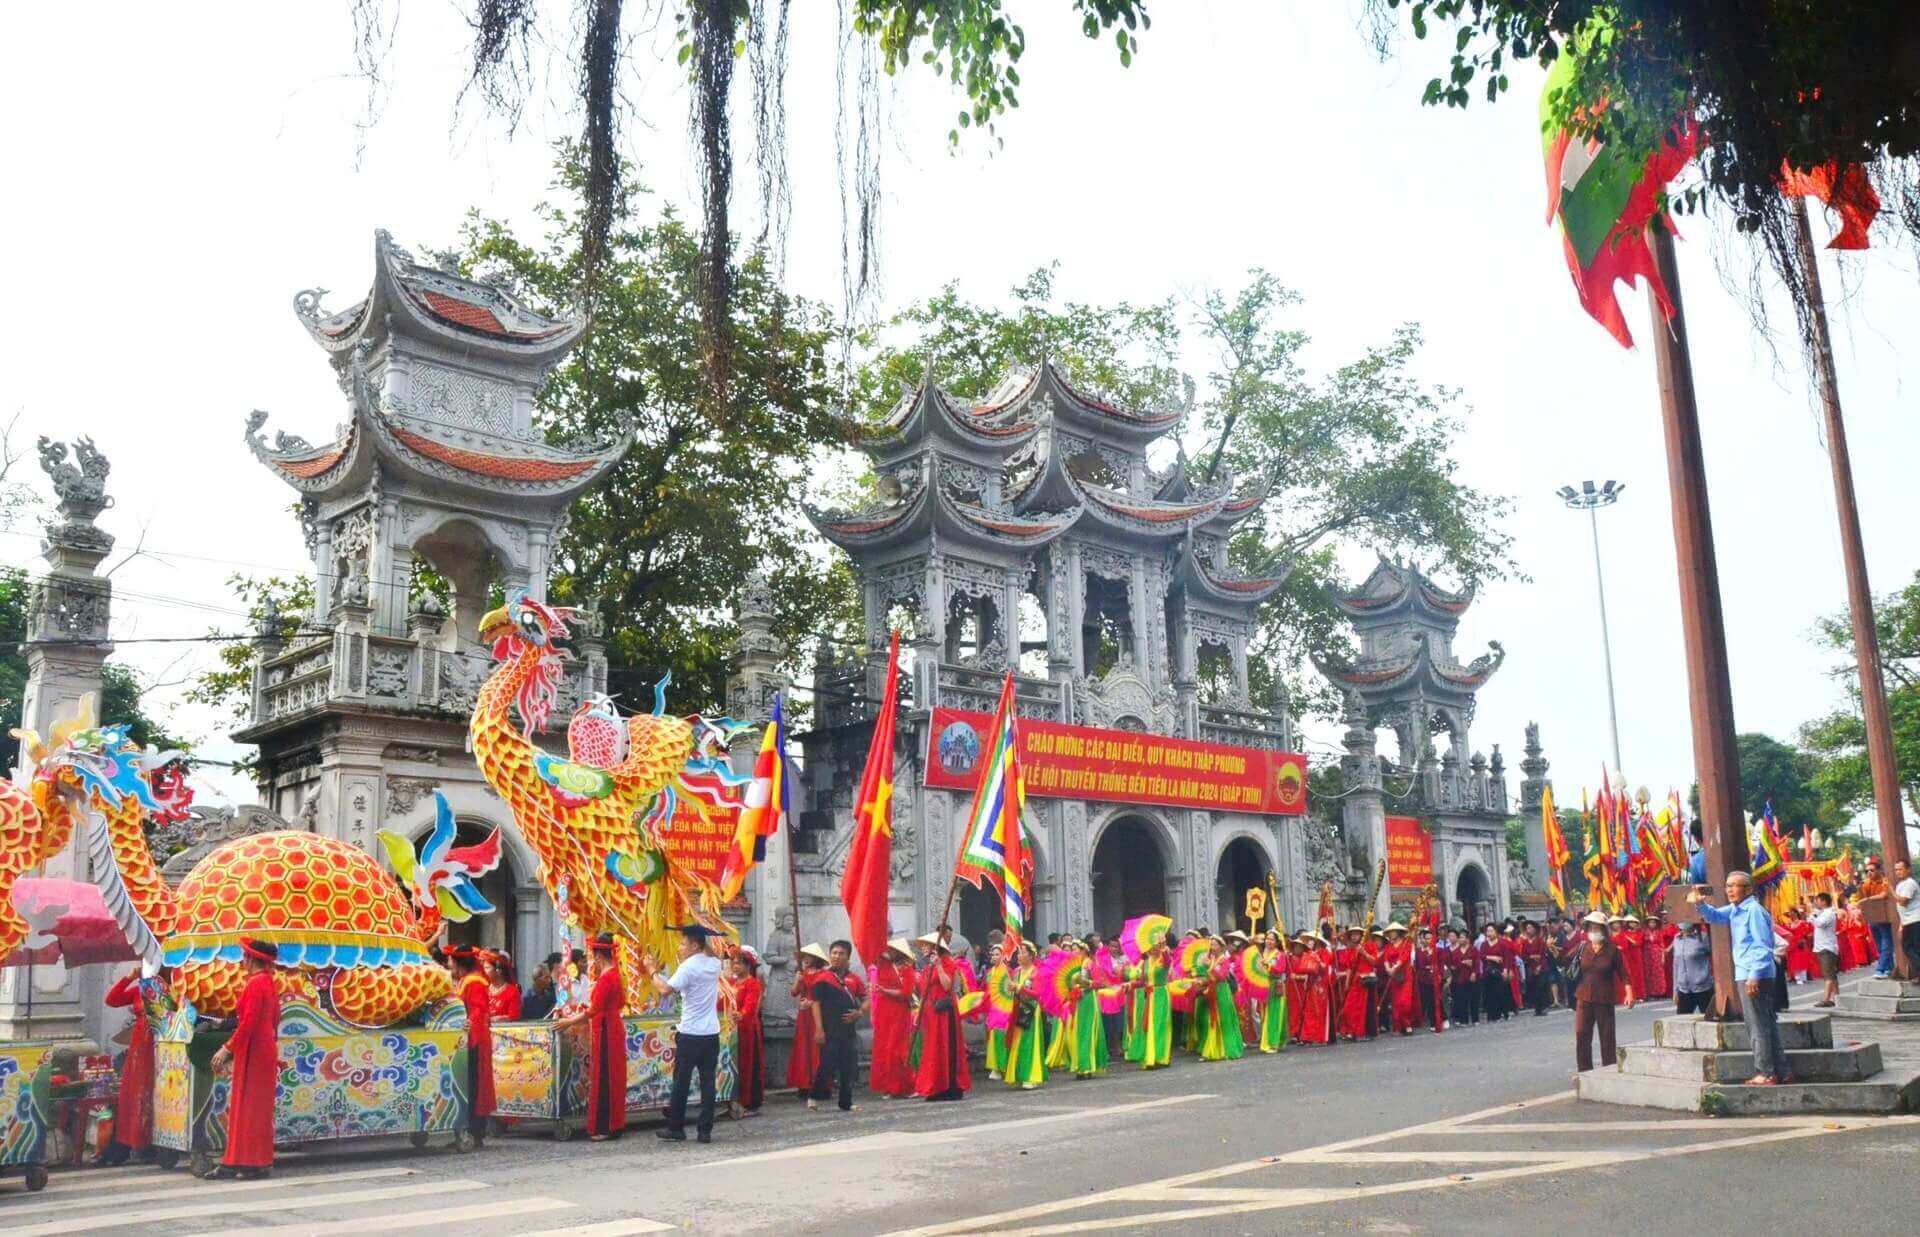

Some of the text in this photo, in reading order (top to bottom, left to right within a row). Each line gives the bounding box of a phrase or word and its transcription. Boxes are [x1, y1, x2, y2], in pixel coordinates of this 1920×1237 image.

[1027, 730, 1055, 754] CHÀO
[1055, 733, 1084, 757] MỪNG
[1085, 736, 1104, 760] CÁC
[1105, 740, 1121, 766] ĐẠI
[1165, 746, 1193, 769] KHÁCH
[1193, 749, 1214, 774] THẬP
[1041, 763, 1059, 791] HỘI
[1168, 777, 1179, 798] LA
[1179, 777, 1199, 799] NĂM
[1199, 782, 1218, 801] 2024
